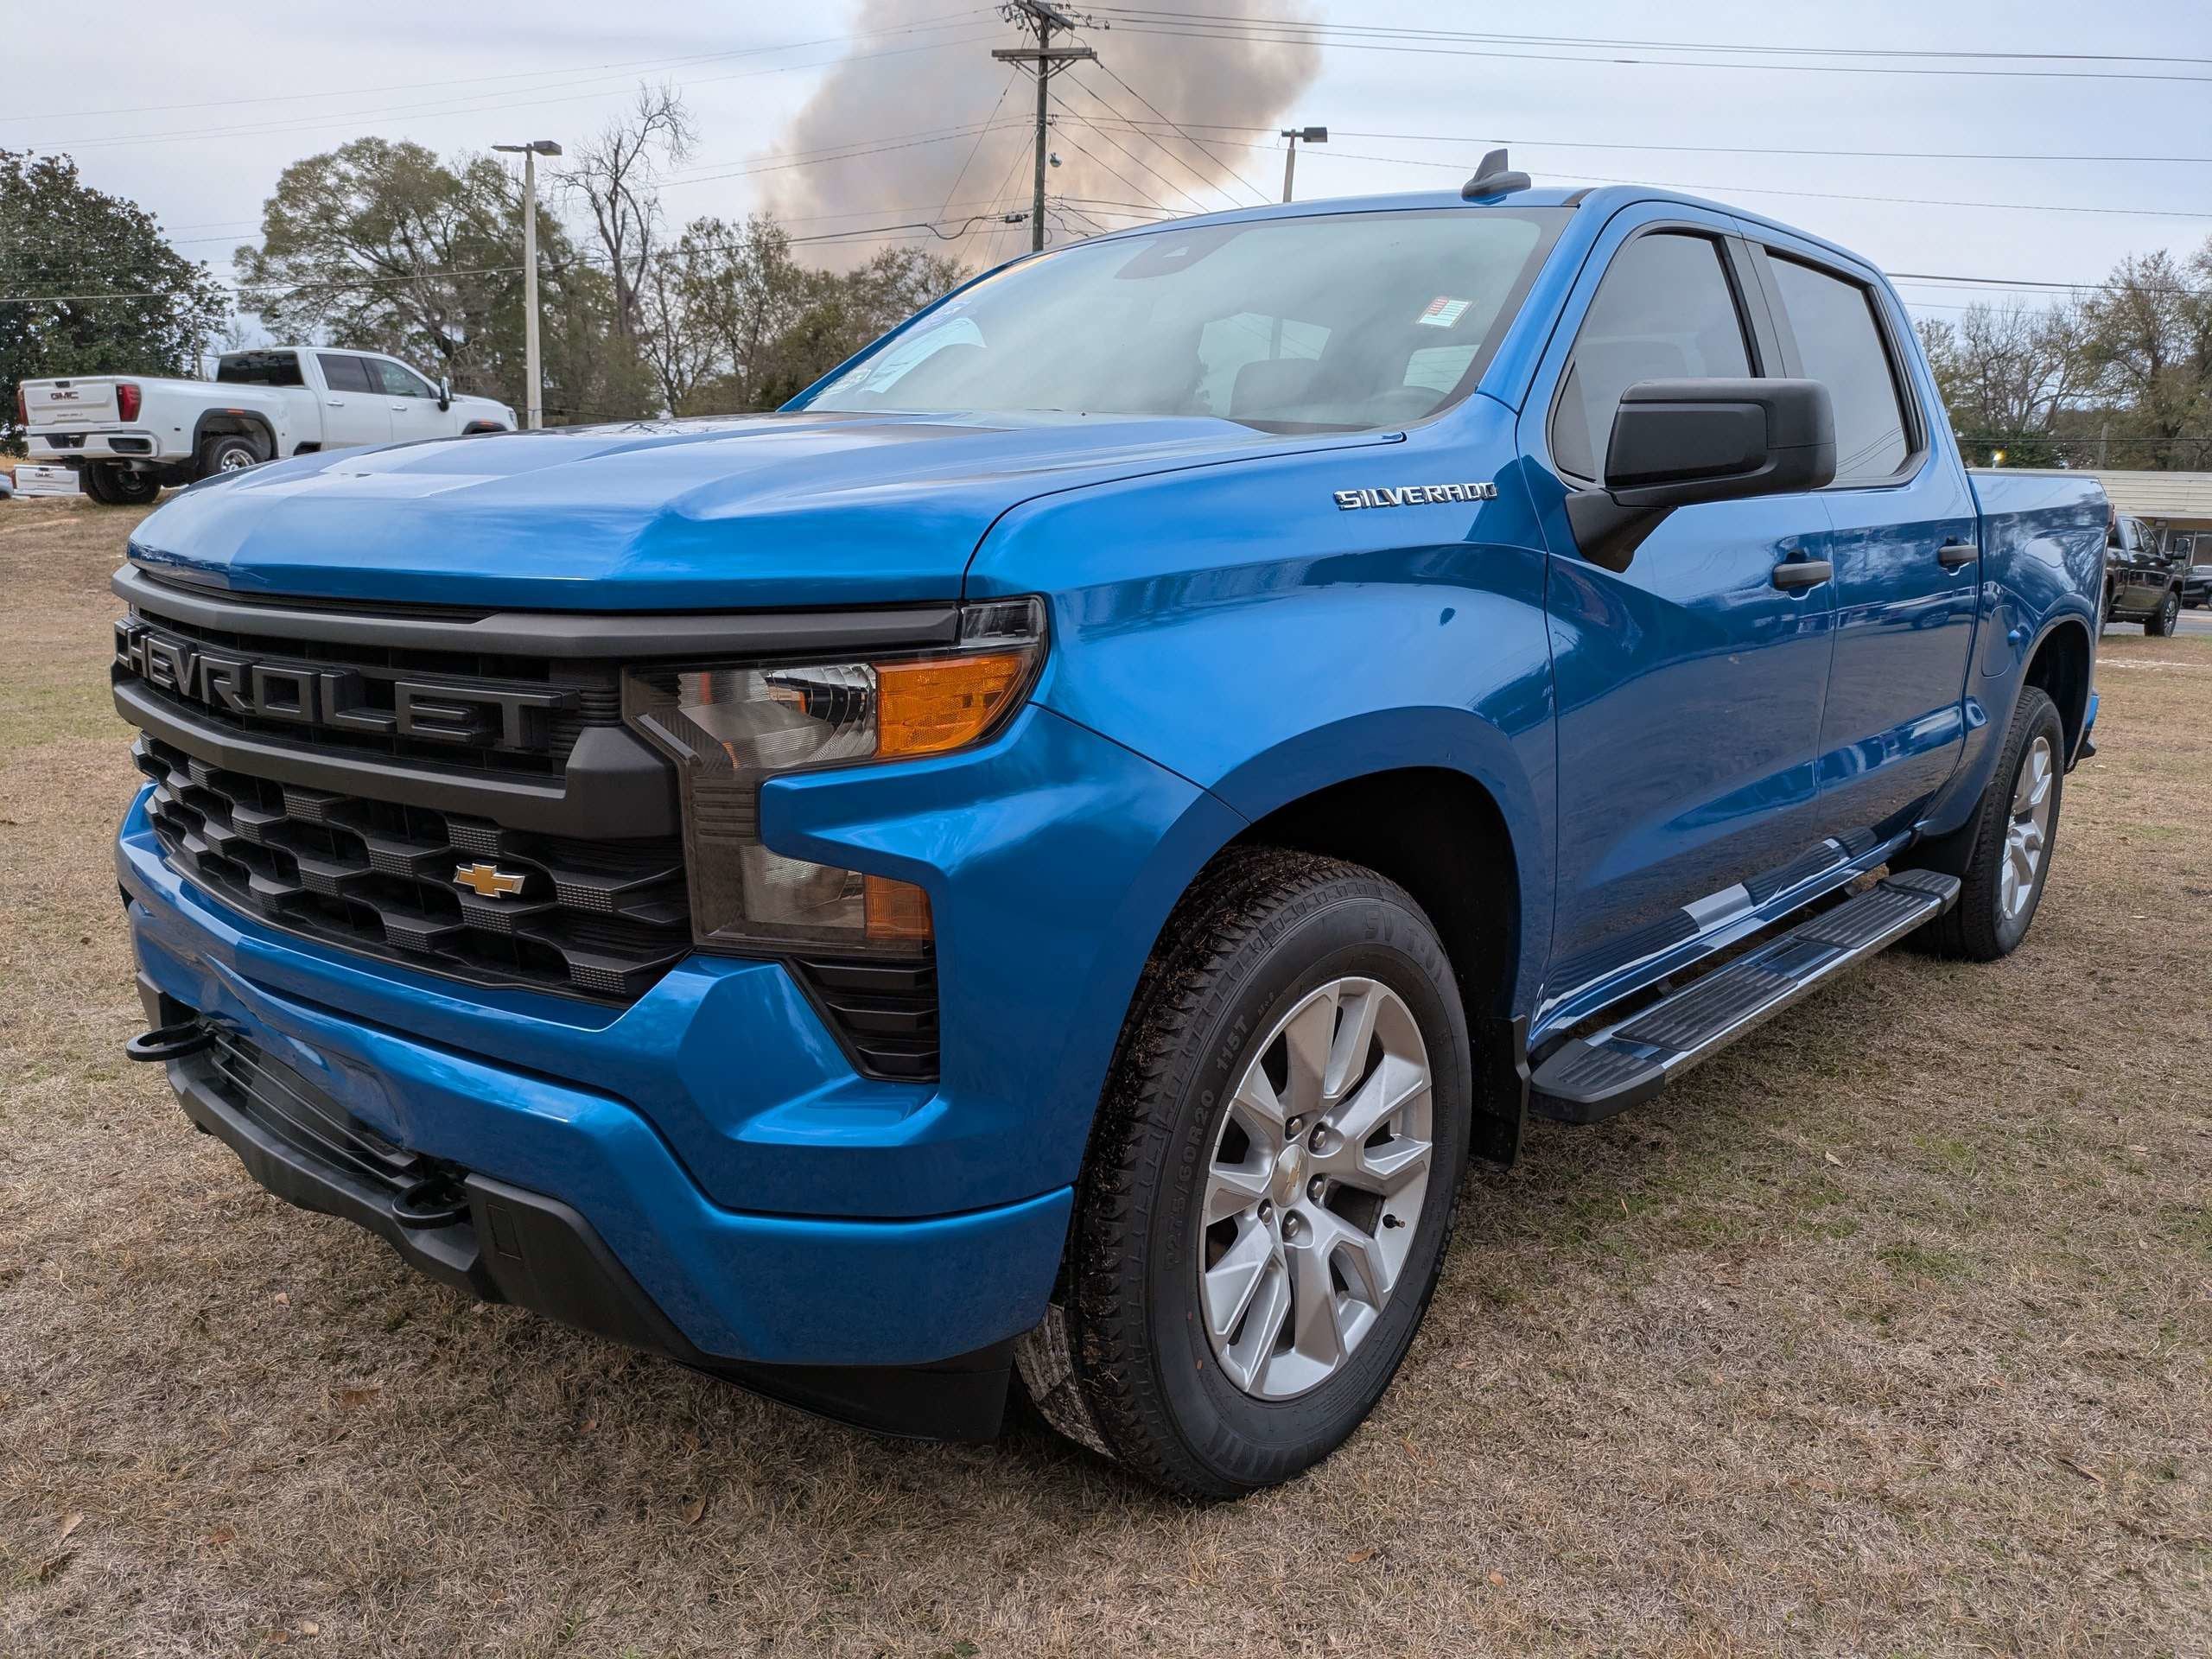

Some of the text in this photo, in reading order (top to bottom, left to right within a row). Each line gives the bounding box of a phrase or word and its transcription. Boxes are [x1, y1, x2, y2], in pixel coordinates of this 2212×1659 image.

[50, 391, 79, 402] GMC
[1334, 481, 1498, 511] SILVERADO
[113, 620, 572, 750] CHEVROLET
